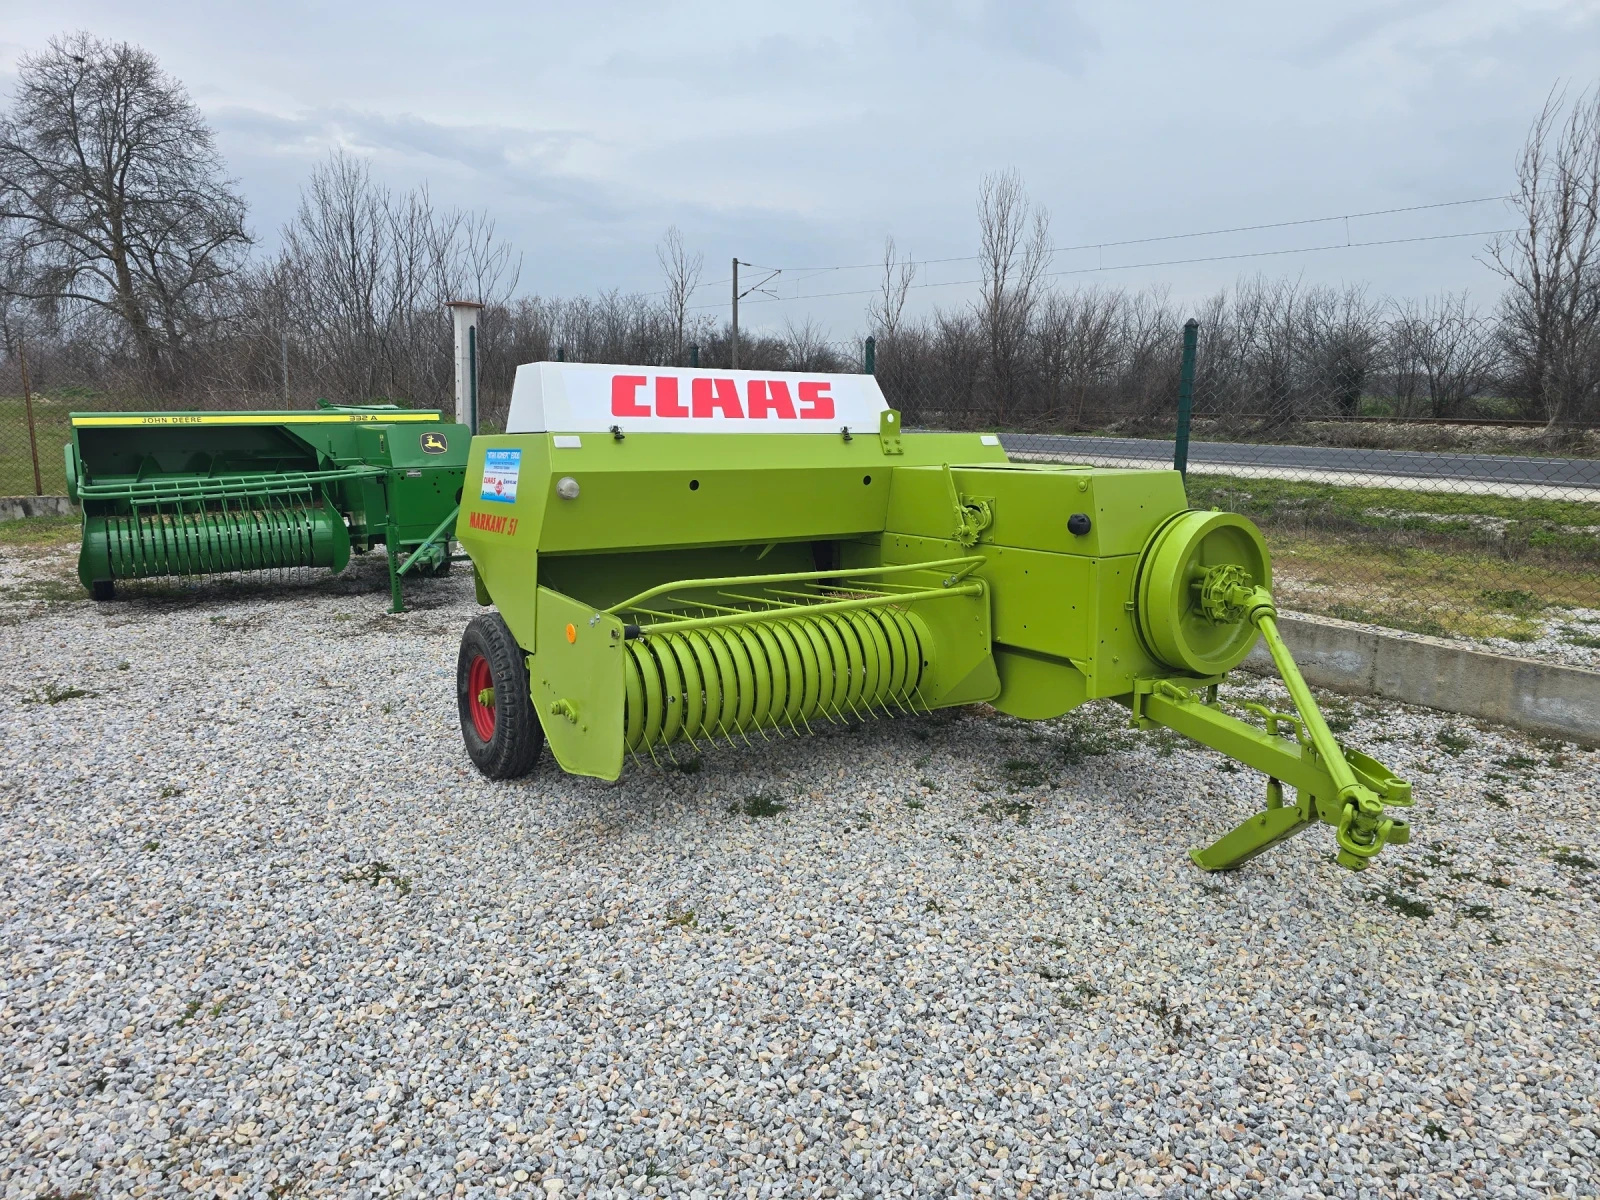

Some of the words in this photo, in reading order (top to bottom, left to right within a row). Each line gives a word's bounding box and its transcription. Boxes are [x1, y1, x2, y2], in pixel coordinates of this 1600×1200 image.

[611, 375, 835, 420] CLAAS
[172, 416, 203, 424] DEERE
[470, 512, 508, 534] MARKANT
